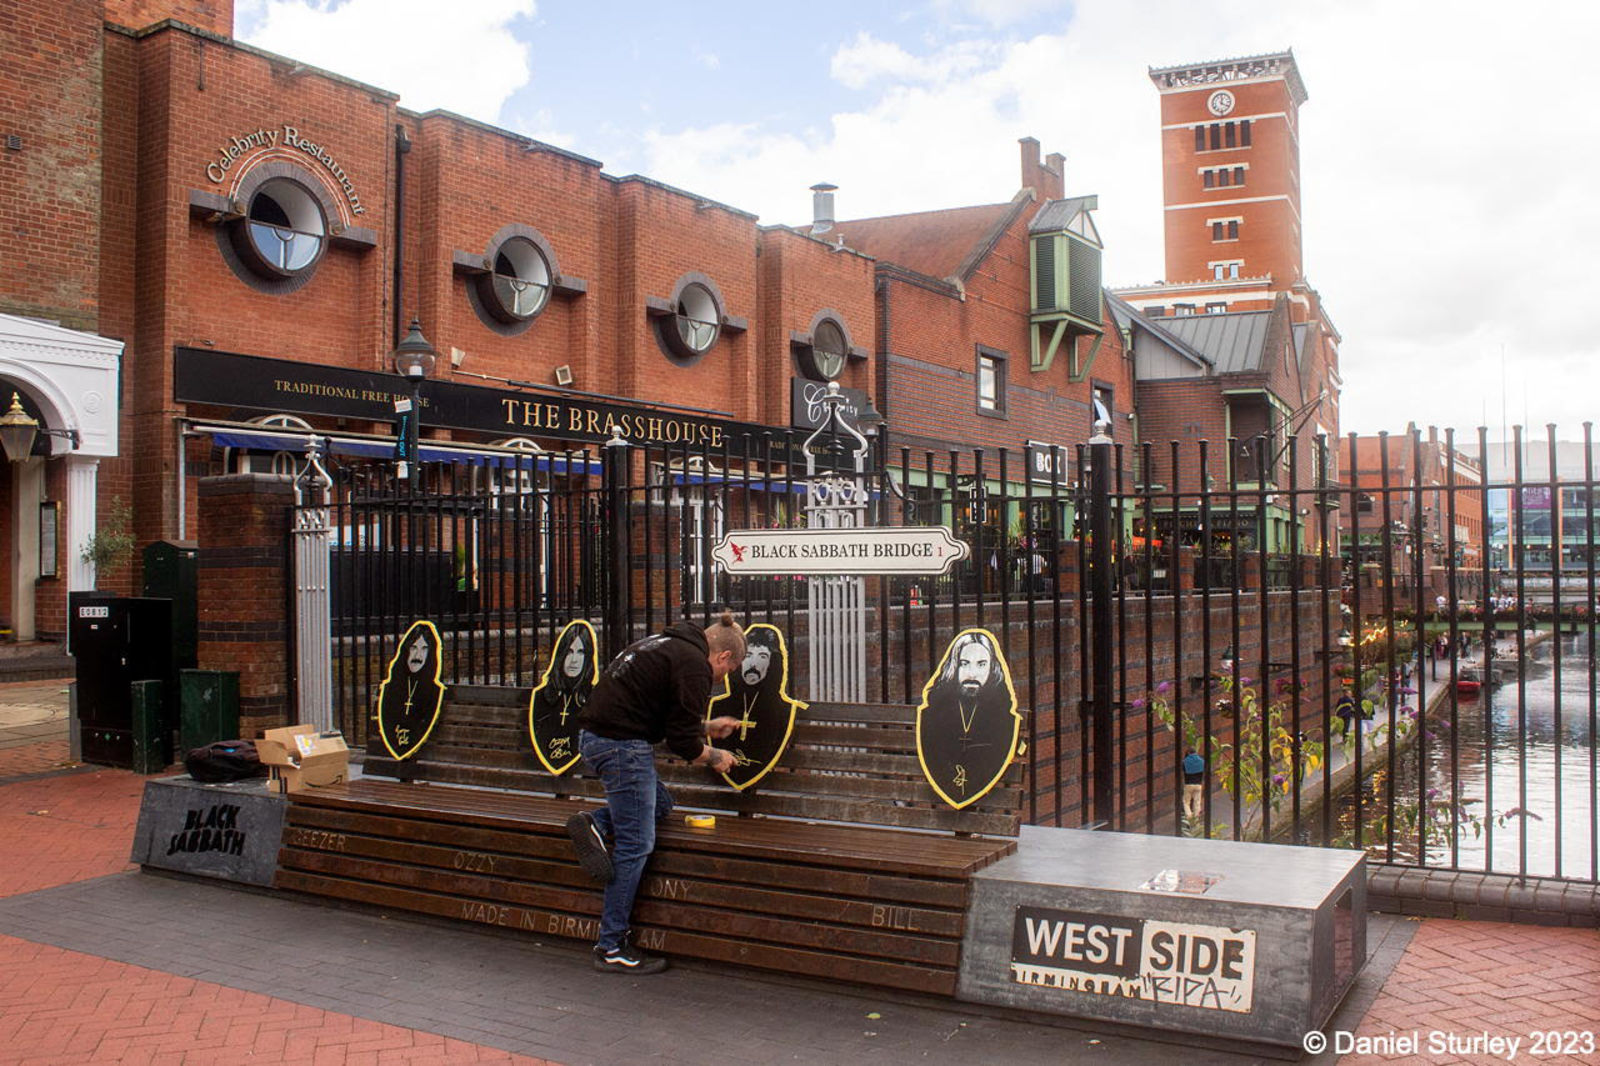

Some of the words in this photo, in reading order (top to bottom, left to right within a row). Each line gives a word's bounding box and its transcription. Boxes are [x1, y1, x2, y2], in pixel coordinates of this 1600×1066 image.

[205, 128, 279, 184] Celebrity
[283, 124, 366, 216] Restaurant
[274, 379, 359, 400] TRADITIONAL
[362, 390, 390, 403] FREE
[394, 393, 430, 408] HOSE
[502, 399, 561, 430] THE
[568, 407, 722, 448] BRASSHOUSE
[751, 544, 798, 558] BLACK
[801, 543, 869, 558] SABBATH
[873, 543, 933, 557] BRIDGE
[937, 546, 943, 557] 1
[184, 804, 241, 830] BLACK
[166, 829, 246, 856] SABBATH
[454, 851, 498, 872] OZZY
[651, 878, 690, 899] ONY
[460, 903, 510, 926] MADE
[519, 909, 536, 930] IN
[872, 904, 920, 930] BILL
[1025, 917, 1133, 966] WEST
[1150, 930, 1245, 980] SIDE
